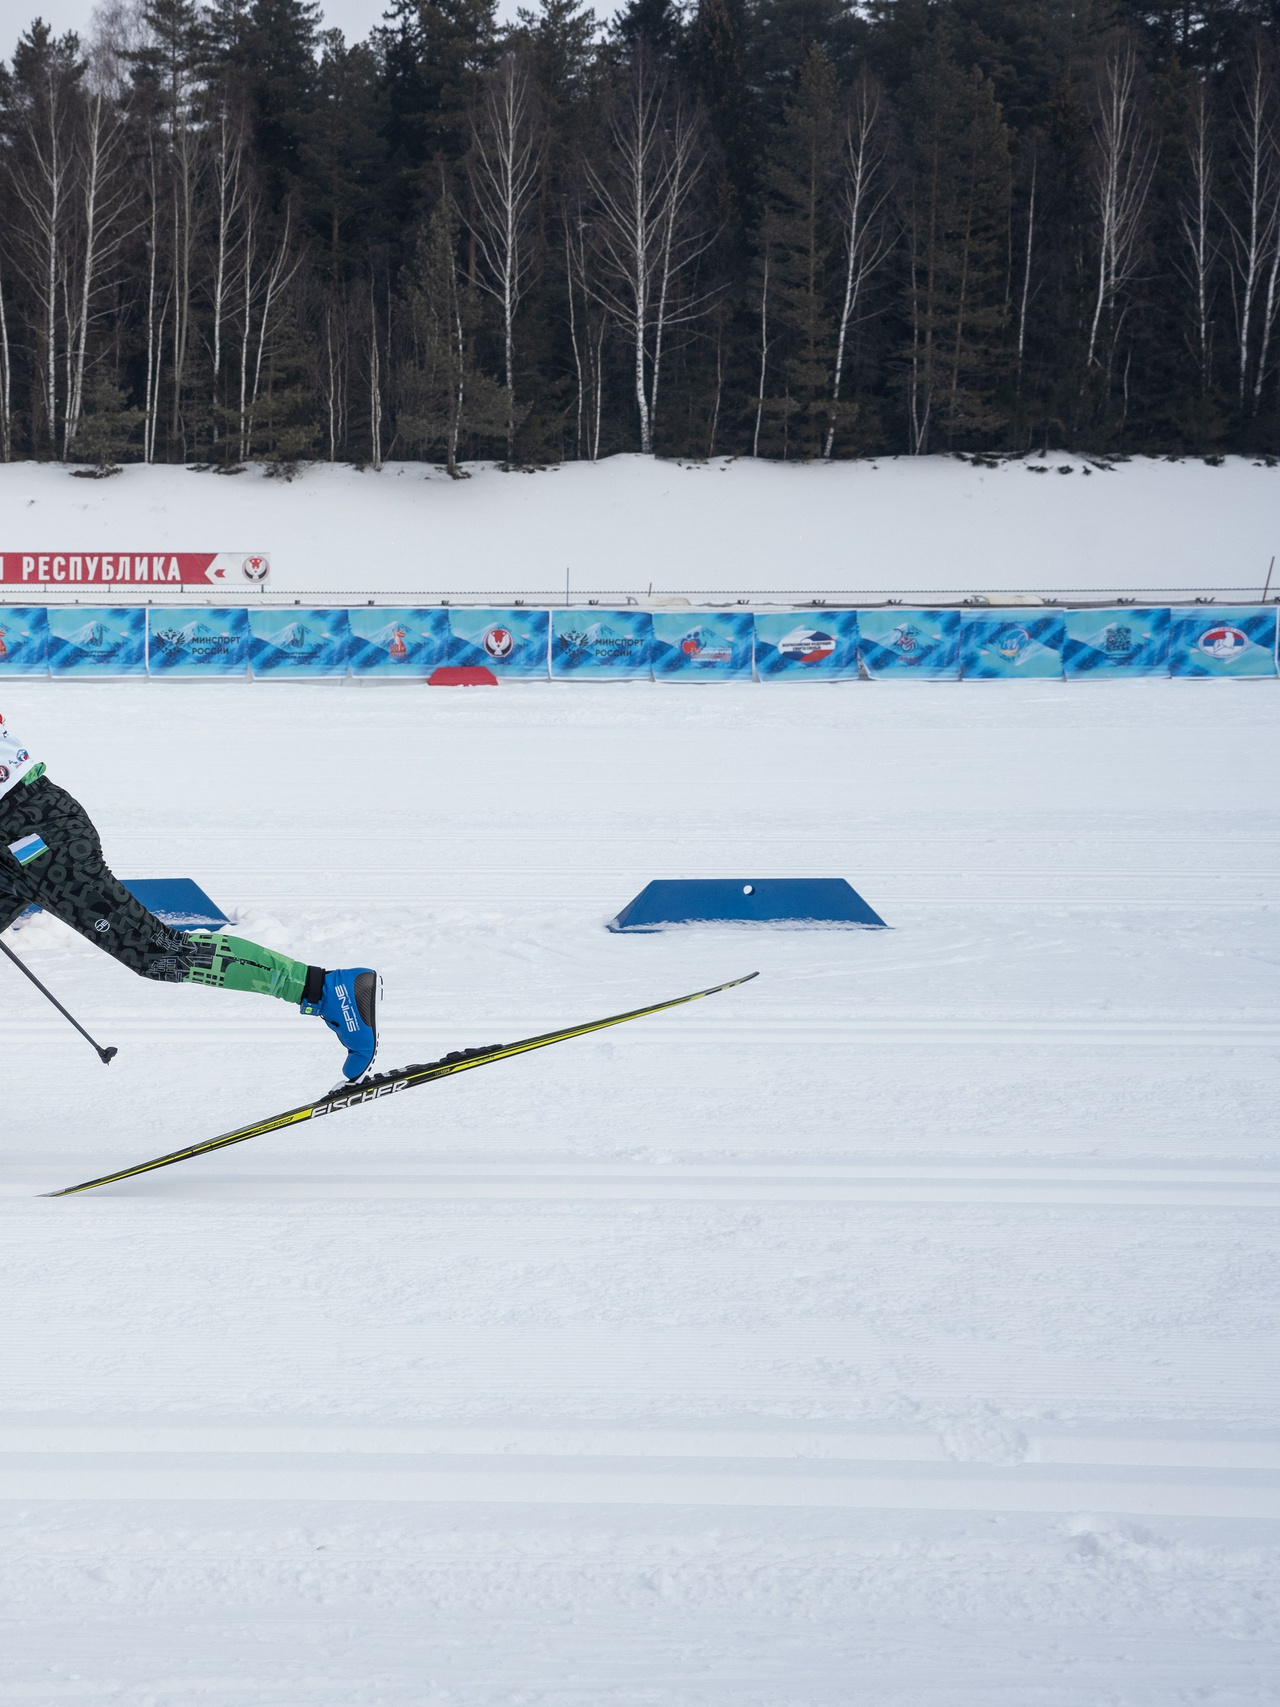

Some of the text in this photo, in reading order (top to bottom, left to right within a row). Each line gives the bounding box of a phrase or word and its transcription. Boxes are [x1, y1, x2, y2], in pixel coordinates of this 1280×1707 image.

[21, 555, 181, 582] РЕСПУБЛИКА
[191, 636, 241, 645] МИНСПОРТ
[595, 638, 644, 647] МИНСПОРТ
[191, 647, 229, 655] РОССИИ
[595, 649, 632, 658] РОССИИ
[334, 985, 357, 1033] SPINE
[311, 1079, 409, 1119] FISCHER
